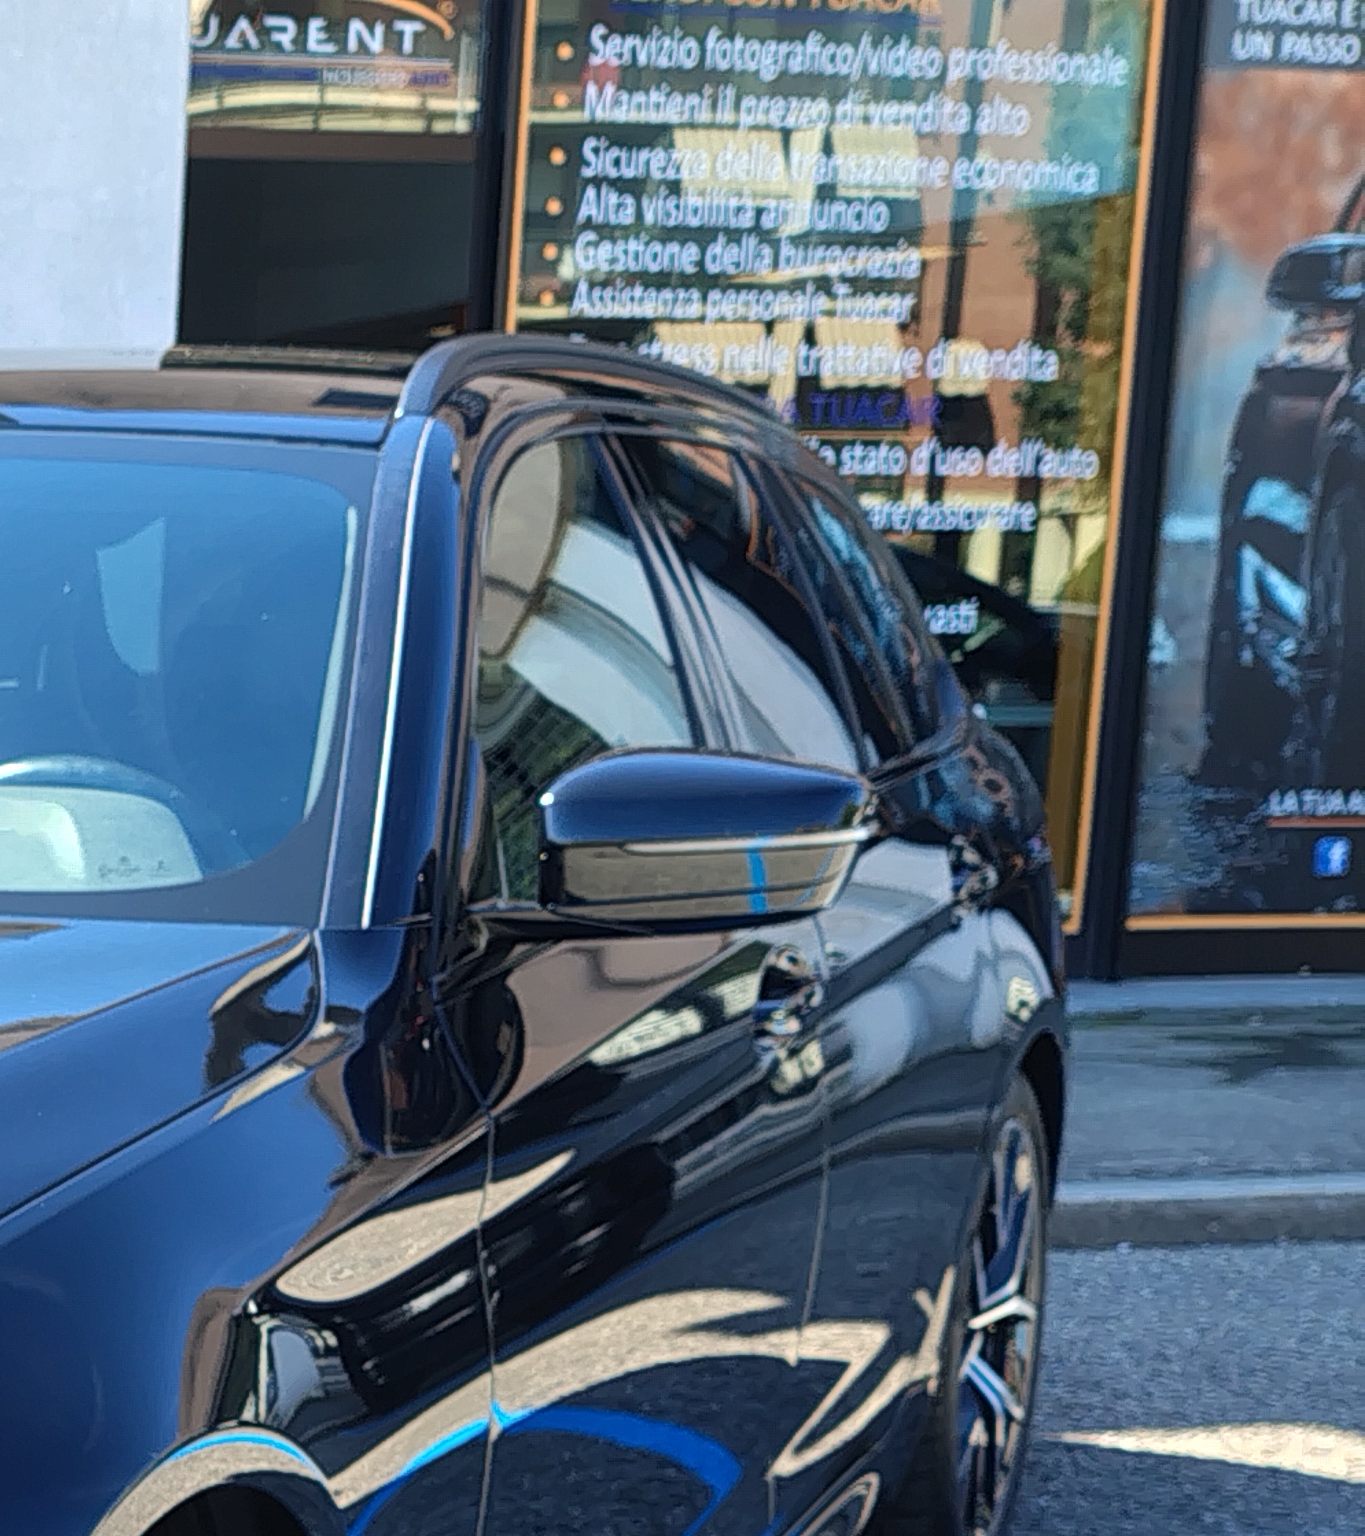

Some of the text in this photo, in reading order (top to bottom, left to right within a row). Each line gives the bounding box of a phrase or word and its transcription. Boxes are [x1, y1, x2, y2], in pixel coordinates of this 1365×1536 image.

[587, 22, 1129, 88] Servizio fotografico/video professionale
[1231, 27, 1362, 65] UN PASSO
[583, 79, 1032, 136] Mantieni il prezzo di vendita alto
[580, 135, 1100, 195] Sicurezza della transazione economica
[576, 182, 637, 227] Alta
[759, 193, 891, 234] annuncio
[573, 230, 921, 280] Gestione della burocrazia
[570, 276, 918, 326] Assistenza personale Tuacar
[723, 332, 791, 376] nelle
[795, 336, 923, 380] trattative
[925, 337, 952, 380] di
[956, 339, 1060, 382] vendita
[808, 391, 943, 428] TUACAR
[838, 438, 908, 477] stato
[910, 436, 984, 477] d'uso
[986, 438, 1100, 480] dell'auto
